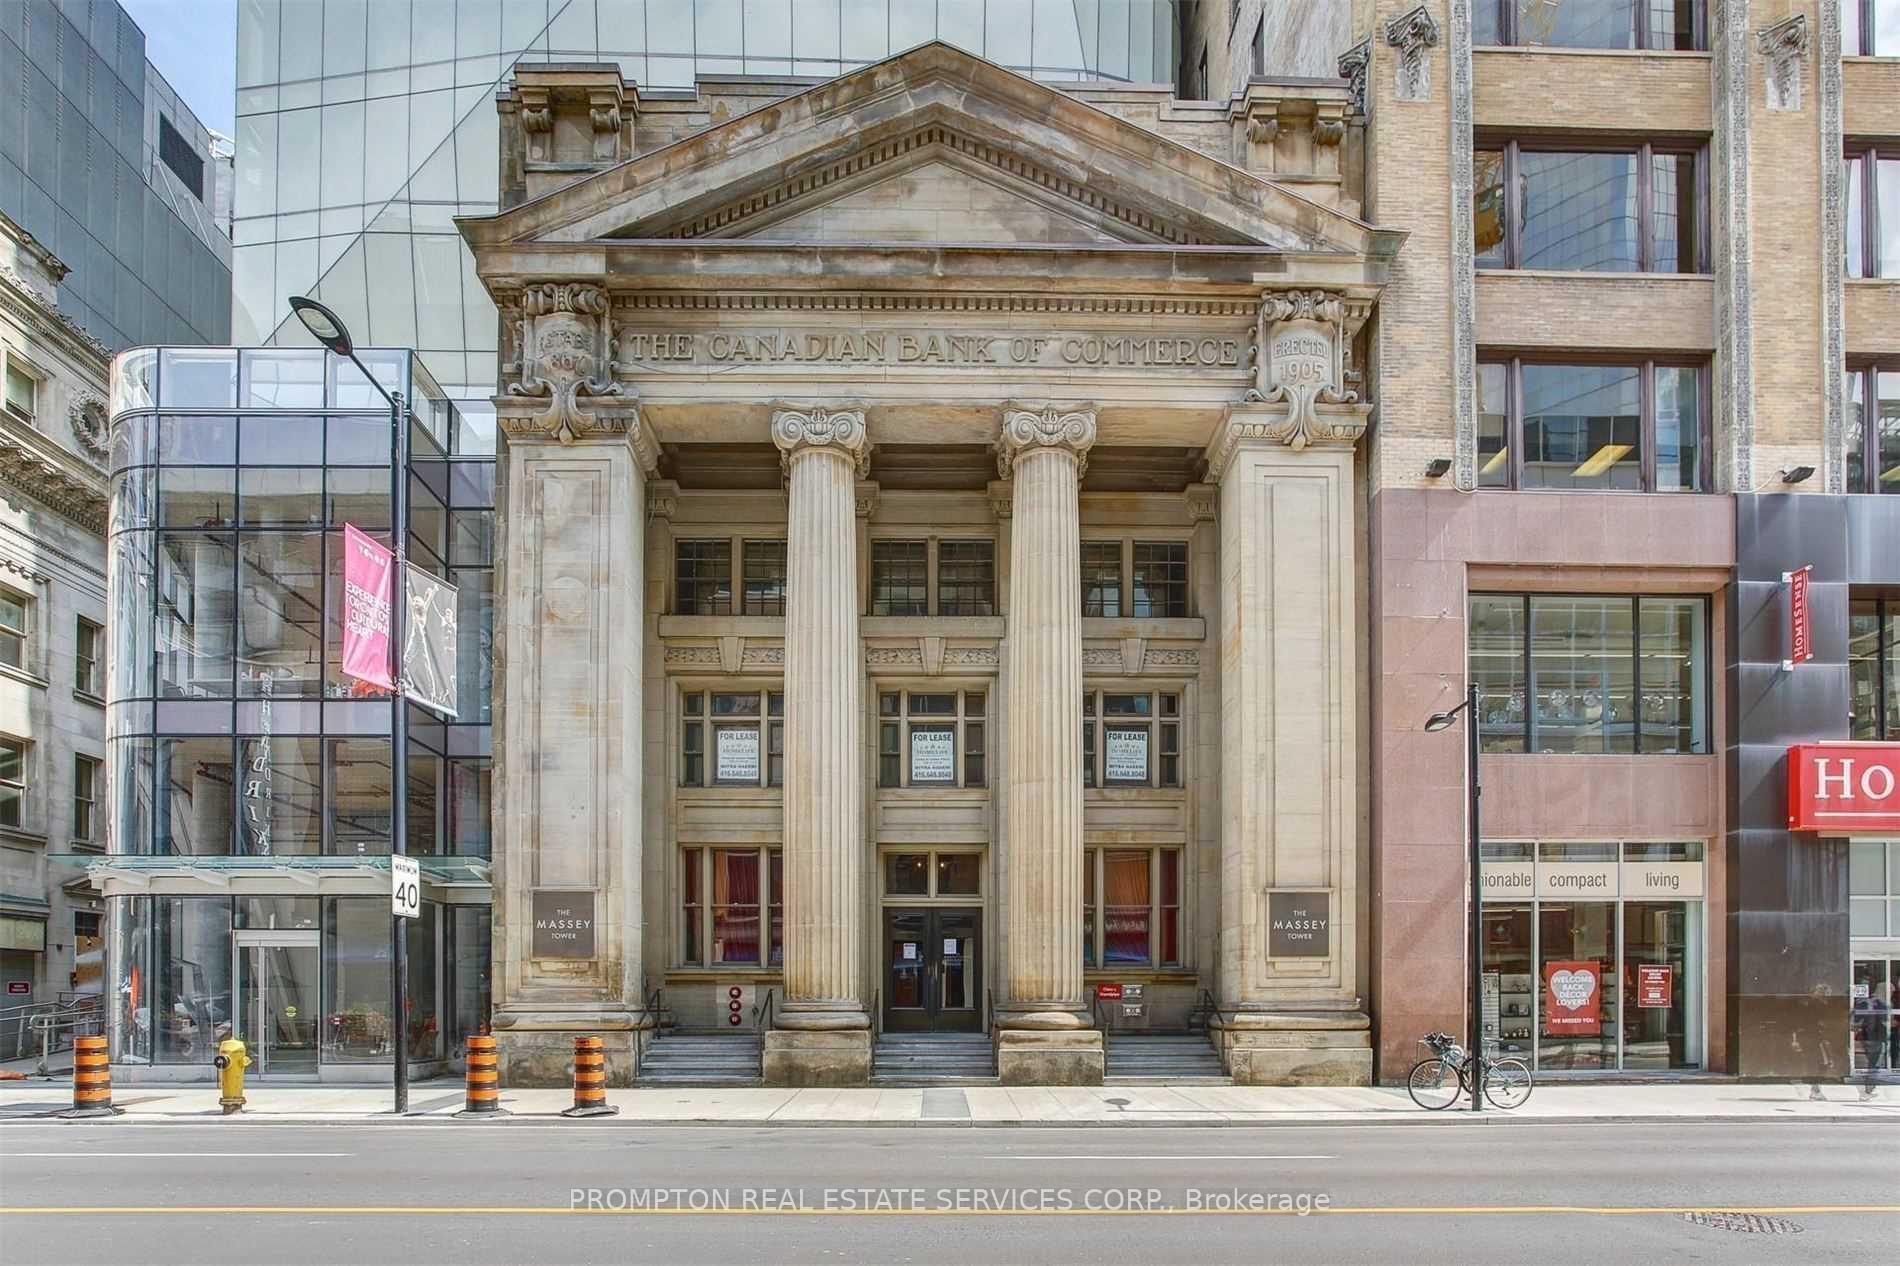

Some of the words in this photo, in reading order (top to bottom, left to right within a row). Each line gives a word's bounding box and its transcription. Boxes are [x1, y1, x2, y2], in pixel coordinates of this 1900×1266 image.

[631, 335, 694, 361] THE
[709, 335, 887, 361] CANADIAN
[898, 336, 996, 363] BANK
[1010, 337, 1050, 362] OF
[1061, 337, 1239, 366] COMMERCE
[1280, 361, 1325, 382] 1905
[720, 732, 734, 740] FOR
[736, 732, 758, 740] LEASE
[914, 734, 928, 742] FOR
[930, 734, 952, 742] LEASE
[1108, 733, 1122, 741] FOR
[1124, 733, 1146, 741] LEASE
[1550, 873, 1607, 889] compact
[1645, 872, 1680, 889] living
[395, 881, 418, 909] 40
[536, 919, 592, 929] MASSEY
[1273, 920, 1327, 930] MASSEY
[552, 932, 576, 940] TOWER
[1552, 975, 1593, 984] WELCOME
